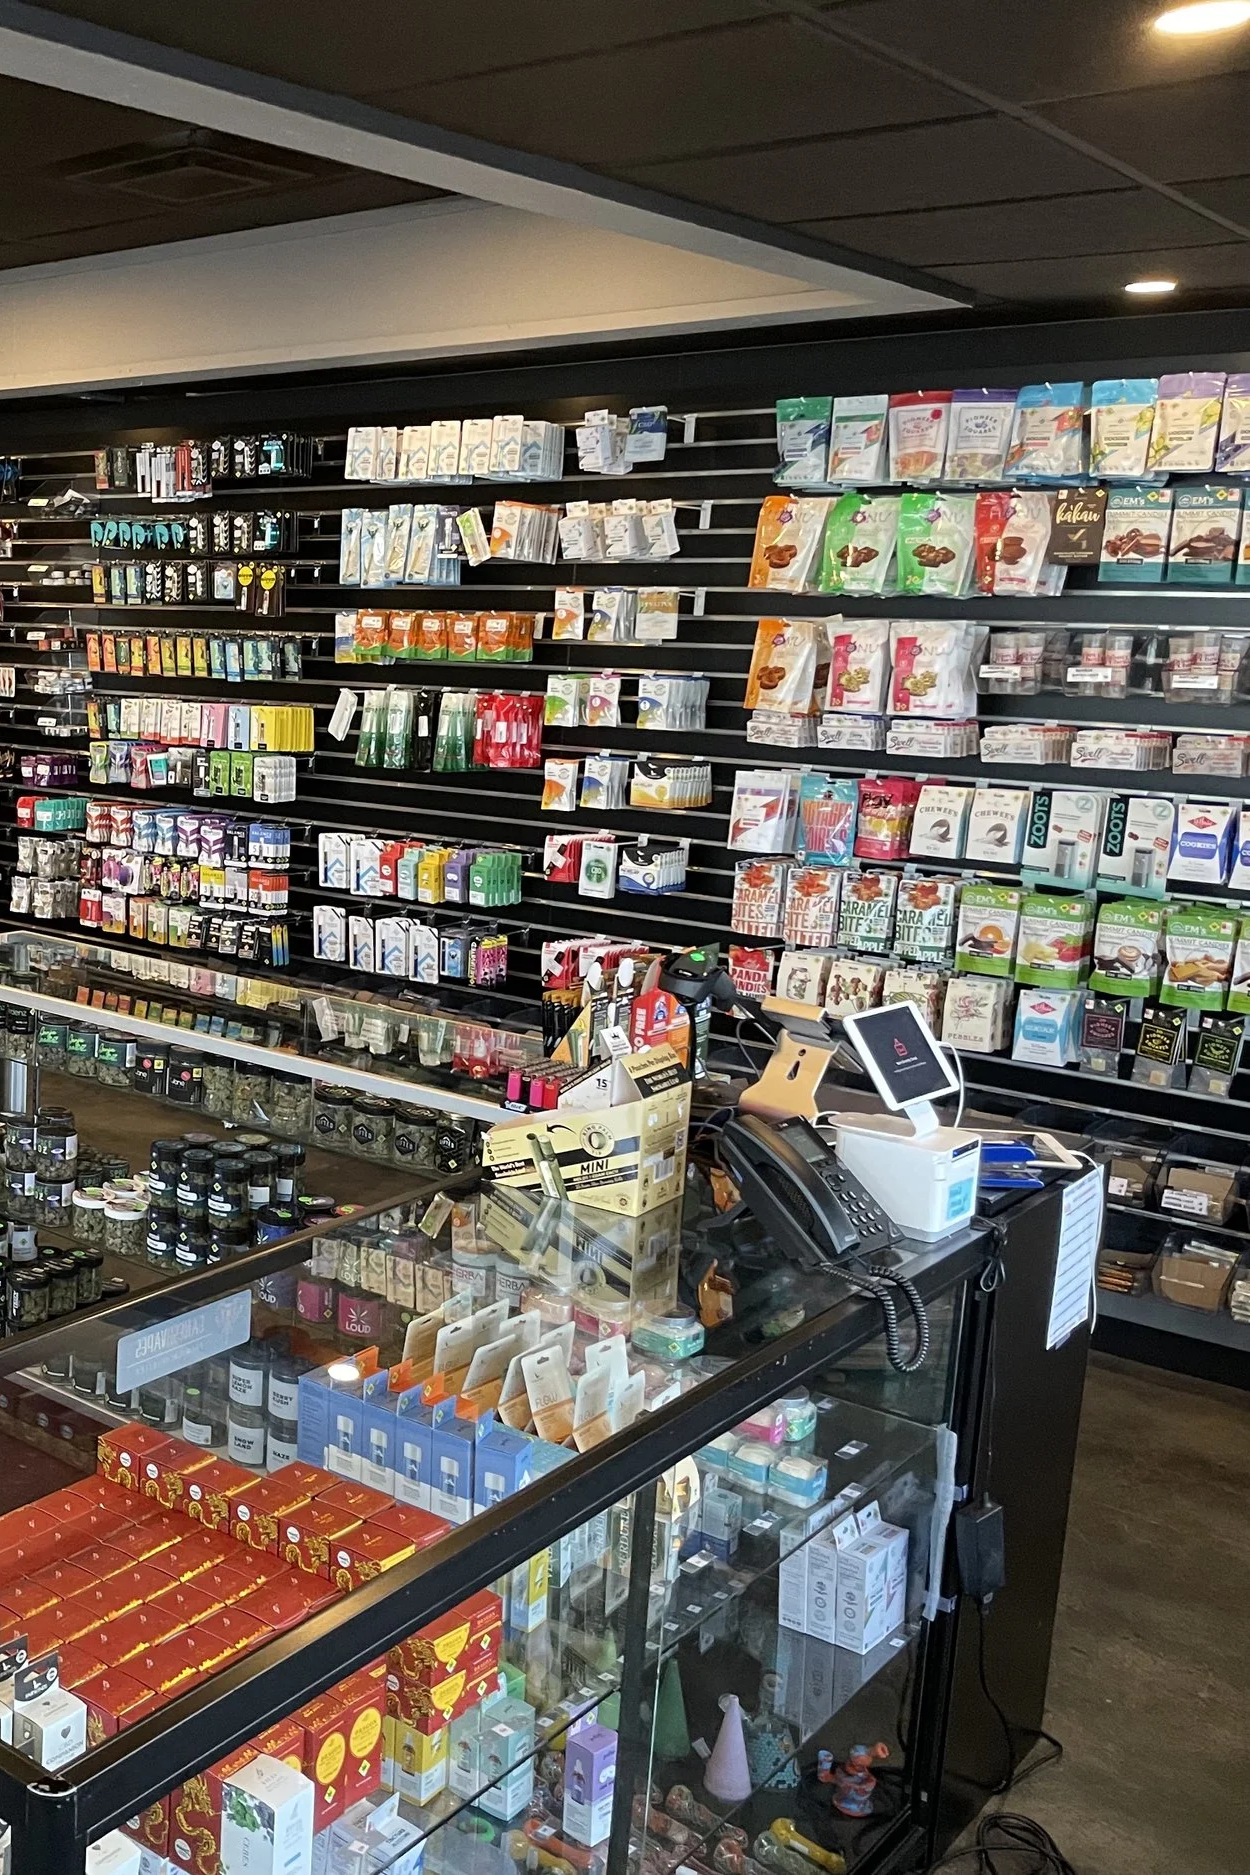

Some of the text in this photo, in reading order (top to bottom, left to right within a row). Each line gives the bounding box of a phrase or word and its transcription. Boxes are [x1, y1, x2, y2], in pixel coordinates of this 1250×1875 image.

[1123, 497, 1145, 506] EM's
[1192, 495, 1214, 505] EM's
[748, 725, 773, 739] Swell
[819, 730, 843, 745] Swell
[888, 735, 915, 751] Swell
[983, 743, 1008, 759] Swell
[1072, 748, 1103, 764] Swell
[1176, 752, 1207, 771] Swell
[1031, 795, 1049, 846] ZOOTS
[1106, 801, 1126, 854] ZOOTS
[735, 888, 781, 904] CARAMEL
[733, 902, 764, 920] BITES
[786, 897, 836, 914] CARAEL
[896, 909, 952, 927] CARAEL
[1113, 913, 1135, 924] EM's
[731, 919, 776, 938] SALTED
[1185, 924, 1207, 936] EM's
[783, 929, 830, 948] SALTED
[857, 941, 885, 953] APPLE
[916, 950, 945, 963] APPLE
[731, 967, 767, 983] PANDA
[736, 981, 768, 994] NDIES
[947, 1032, 984, 1042] PEBBLES
[596, 1077, 608, 1088] 15
[580, 1158, 610, 1175] MINI
[258, 1290, 277, 1304] OUD
[345, 1321, 371, 1335] LOUD
[231, 1374, 251, 1384] SUPER
[231, 1380, 253, 1390] LEMON
[272, 1391, 293, 1402] BERRY
[535, 1391, 559, 1409] FLOW
[233, 1441, 252, 1451] LAND
[234, 1435, 255, 1446] SNOW
[272, 1450, 291, 1461] HAZE
[46, 1739, 84, 1765] COMPANION
